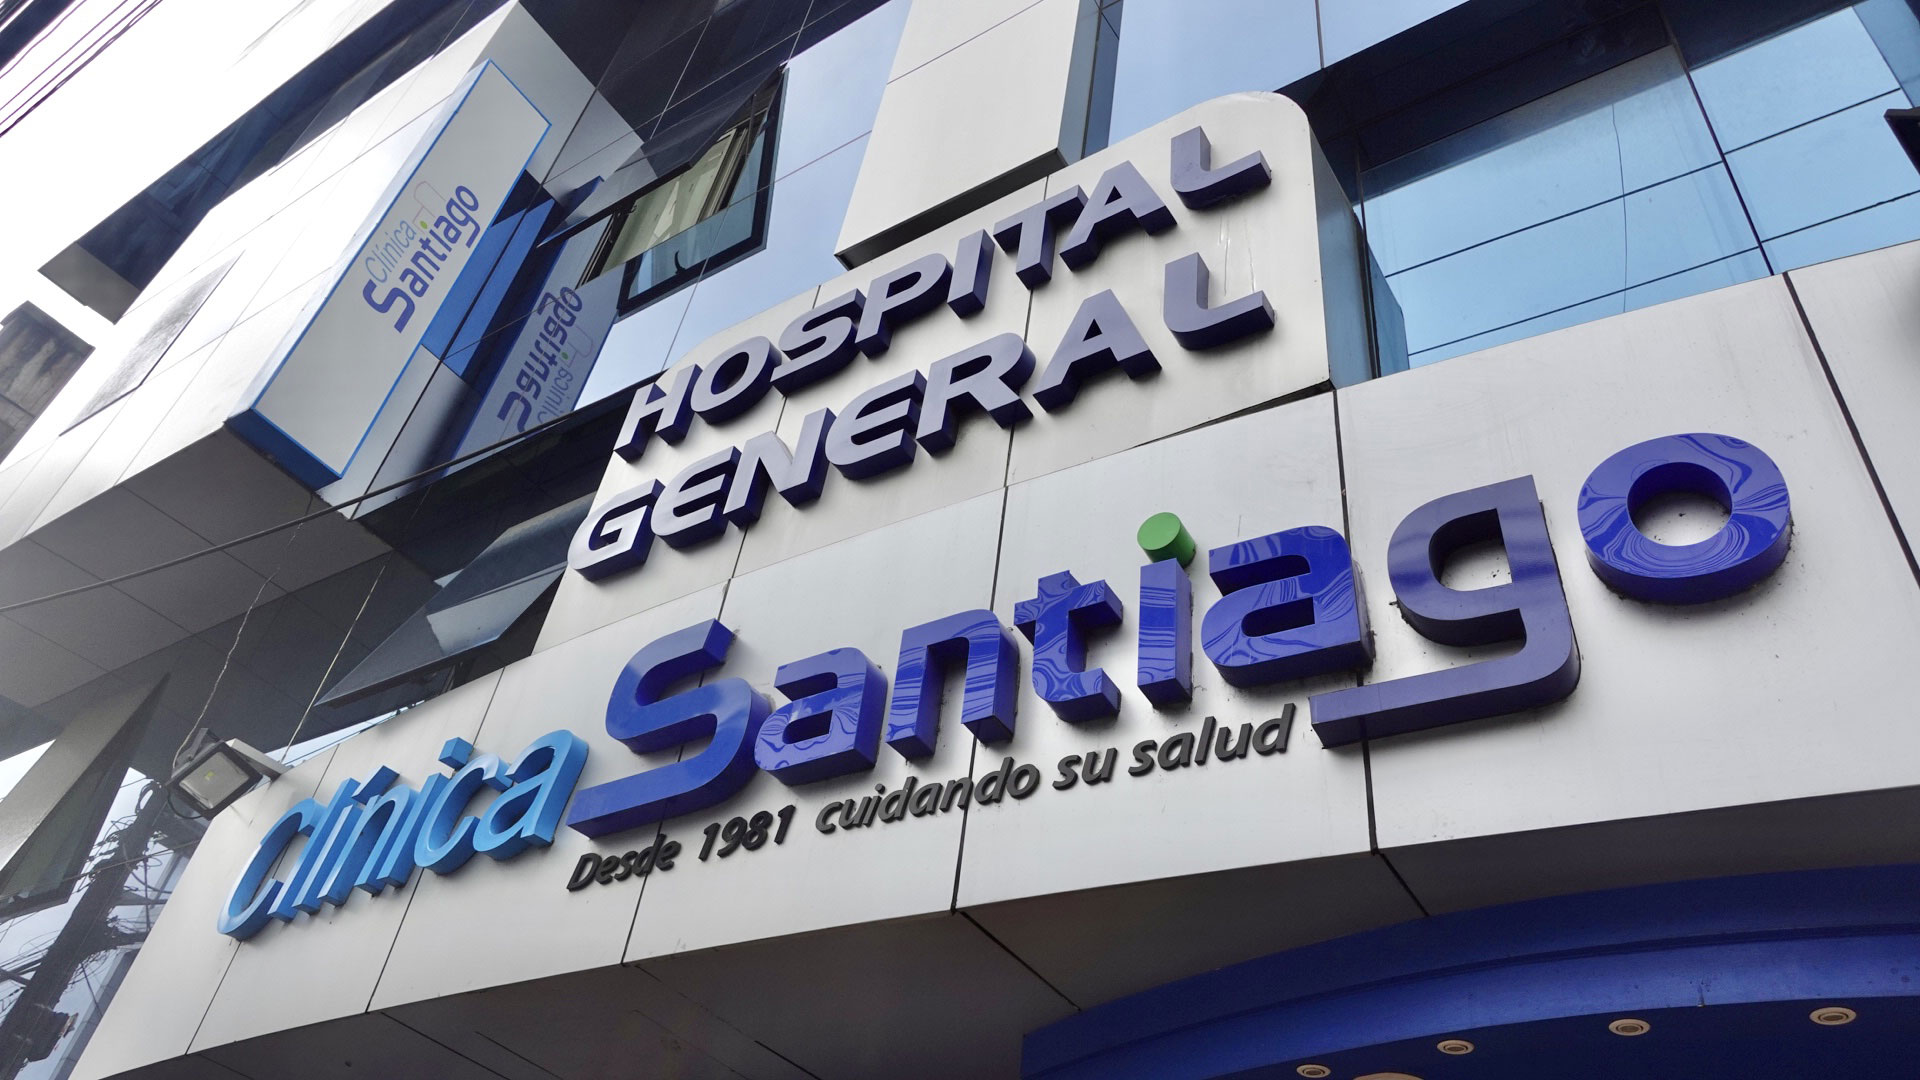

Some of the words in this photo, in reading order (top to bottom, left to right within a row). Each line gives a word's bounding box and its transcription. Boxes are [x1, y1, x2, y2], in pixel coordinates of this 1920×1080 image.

[362, 185, 481, 334] Santiago
[364, 220, 416, 284] Clínica
[614, 126, 1271, 463] HOSPITAL
[569, 252, 1275, 581] GENERAL
[217, 729, 589, 941] Clínica
[566, 432, 1792, 839] Santiago
[567, 833, 681, 892] Desde
[698, 804, 796, 861] 1981
[815, 756, 1040, 834] cuidando
[1052, 747, 1117, 791] su
[1127, 702, 1297, 778] salud
